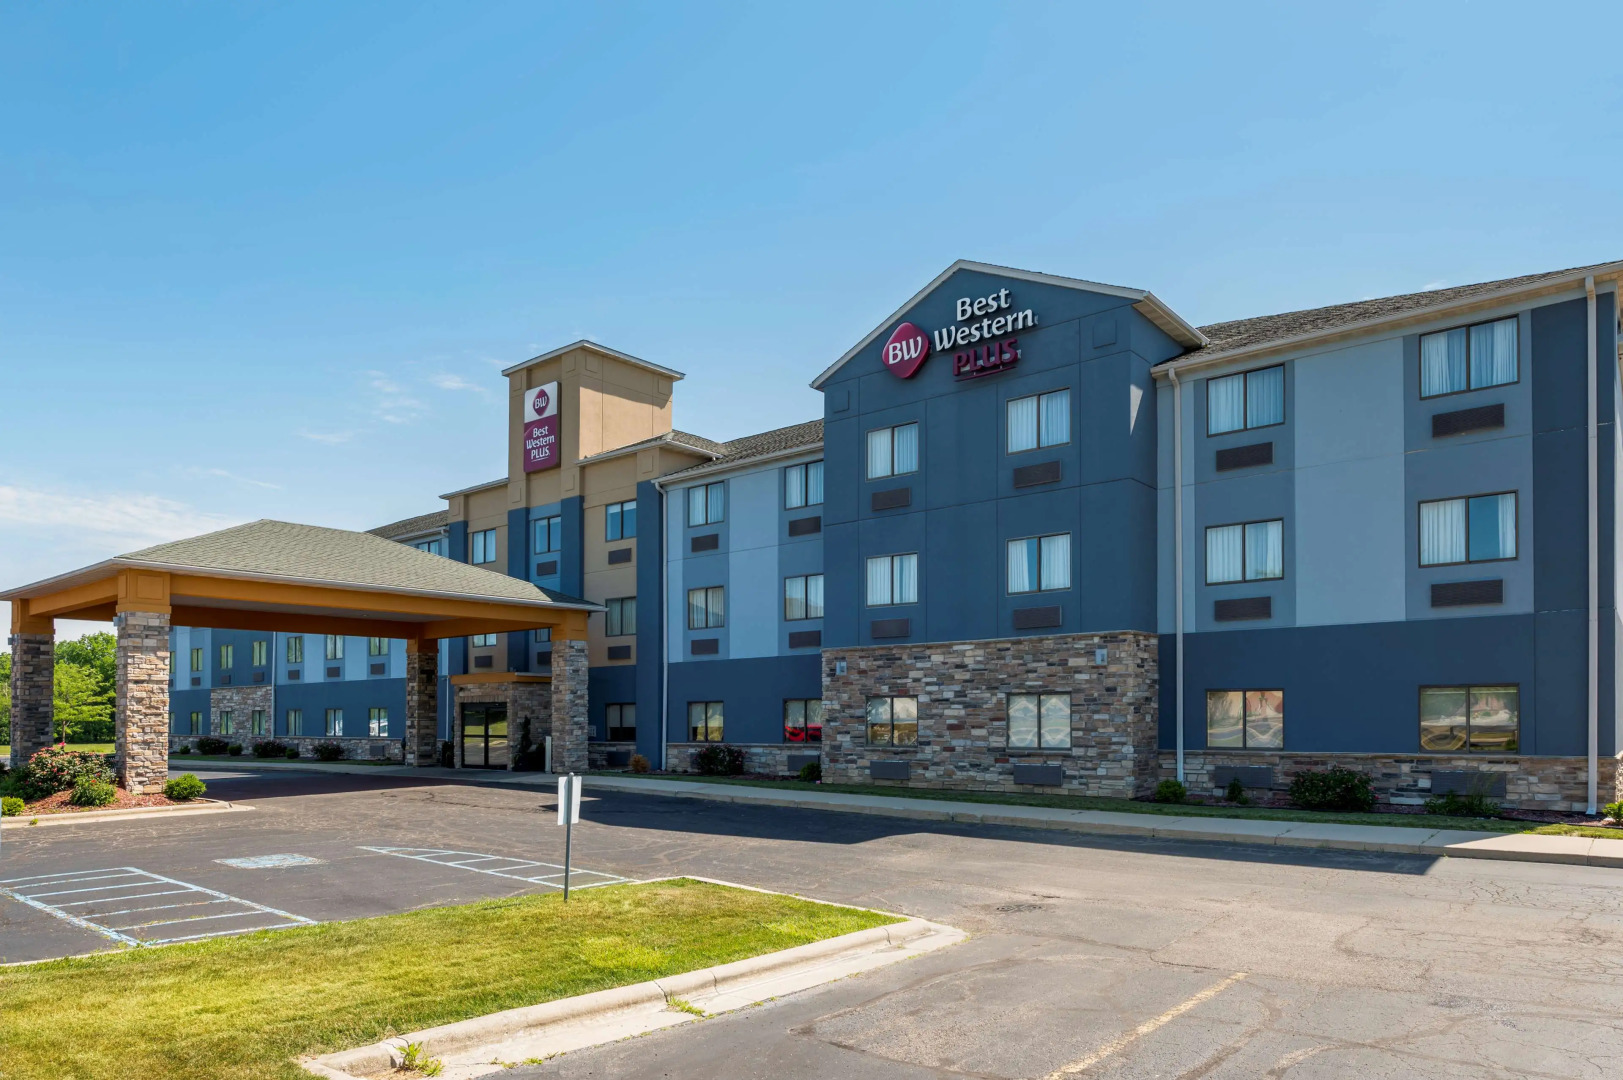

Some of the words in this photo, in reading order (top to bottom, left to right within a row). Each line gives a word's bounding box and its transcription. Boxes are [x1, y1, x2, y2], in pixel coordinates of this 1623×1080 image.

[956, 287, 1010, 322] Best
[933, 308, 1034, 352] Western
[888, 336, 922, 365] BW
[953, 338, 1018, 376] PLUS
[534, 395, 548, 409] BW
[526, 435, 555, 449] Western
[532, 425, 548, 438] Best
[531, 446, 550, 459] PLUS
